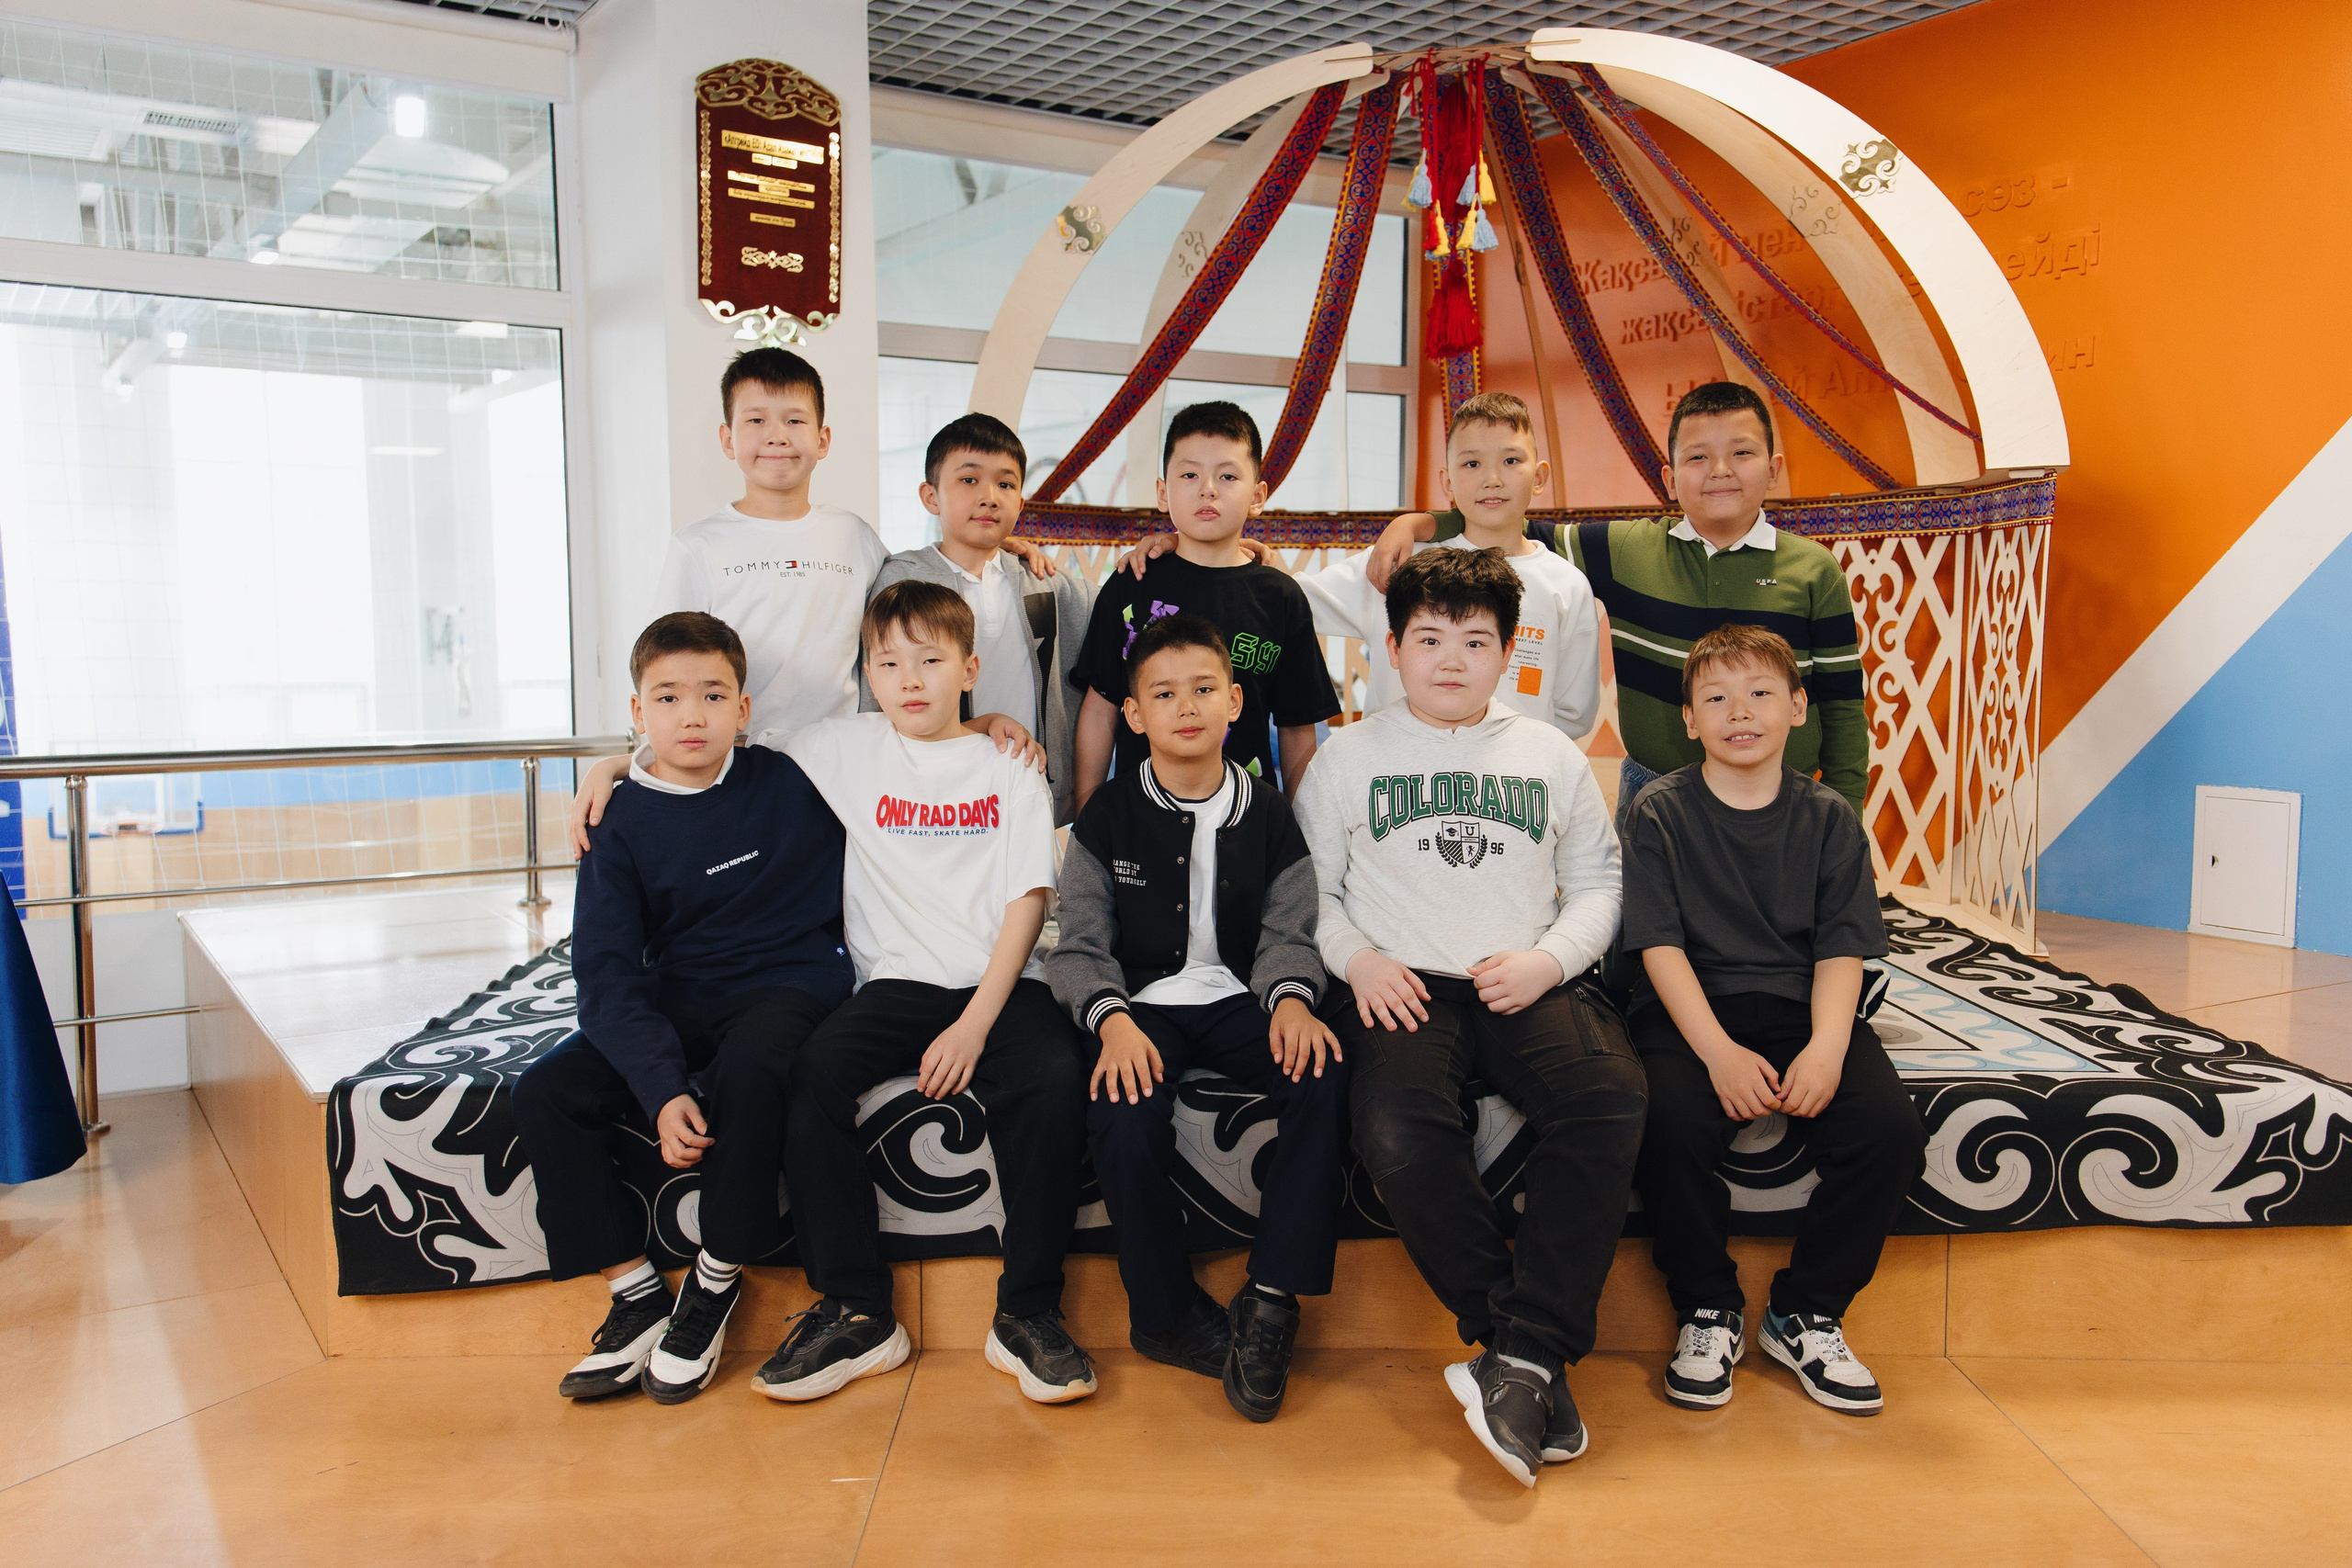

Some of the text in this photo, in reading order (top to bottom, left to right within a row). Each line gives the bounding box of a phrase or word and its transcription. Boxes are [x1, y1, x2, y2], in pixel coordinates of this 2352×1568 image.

[1963, 175, 2036, 217] сөз
[723, 560, 854, 577] TOMMY HILFIGER
[876, 794, 1000, 829] ONLY RAD DAYS
[1368, 772, 1548, 844] COLORADO
[963, 828, 989, 836] HARD.
[1465, 826, 1475, 836] U
[1418, 839, 1504, 855] 19 96
[706, 850, 759, 875] QAZAQ REPUBLIC
[1114, 866, 1130, 874] ORLD
[1694, 1308, 1721, 1320] NIKE
